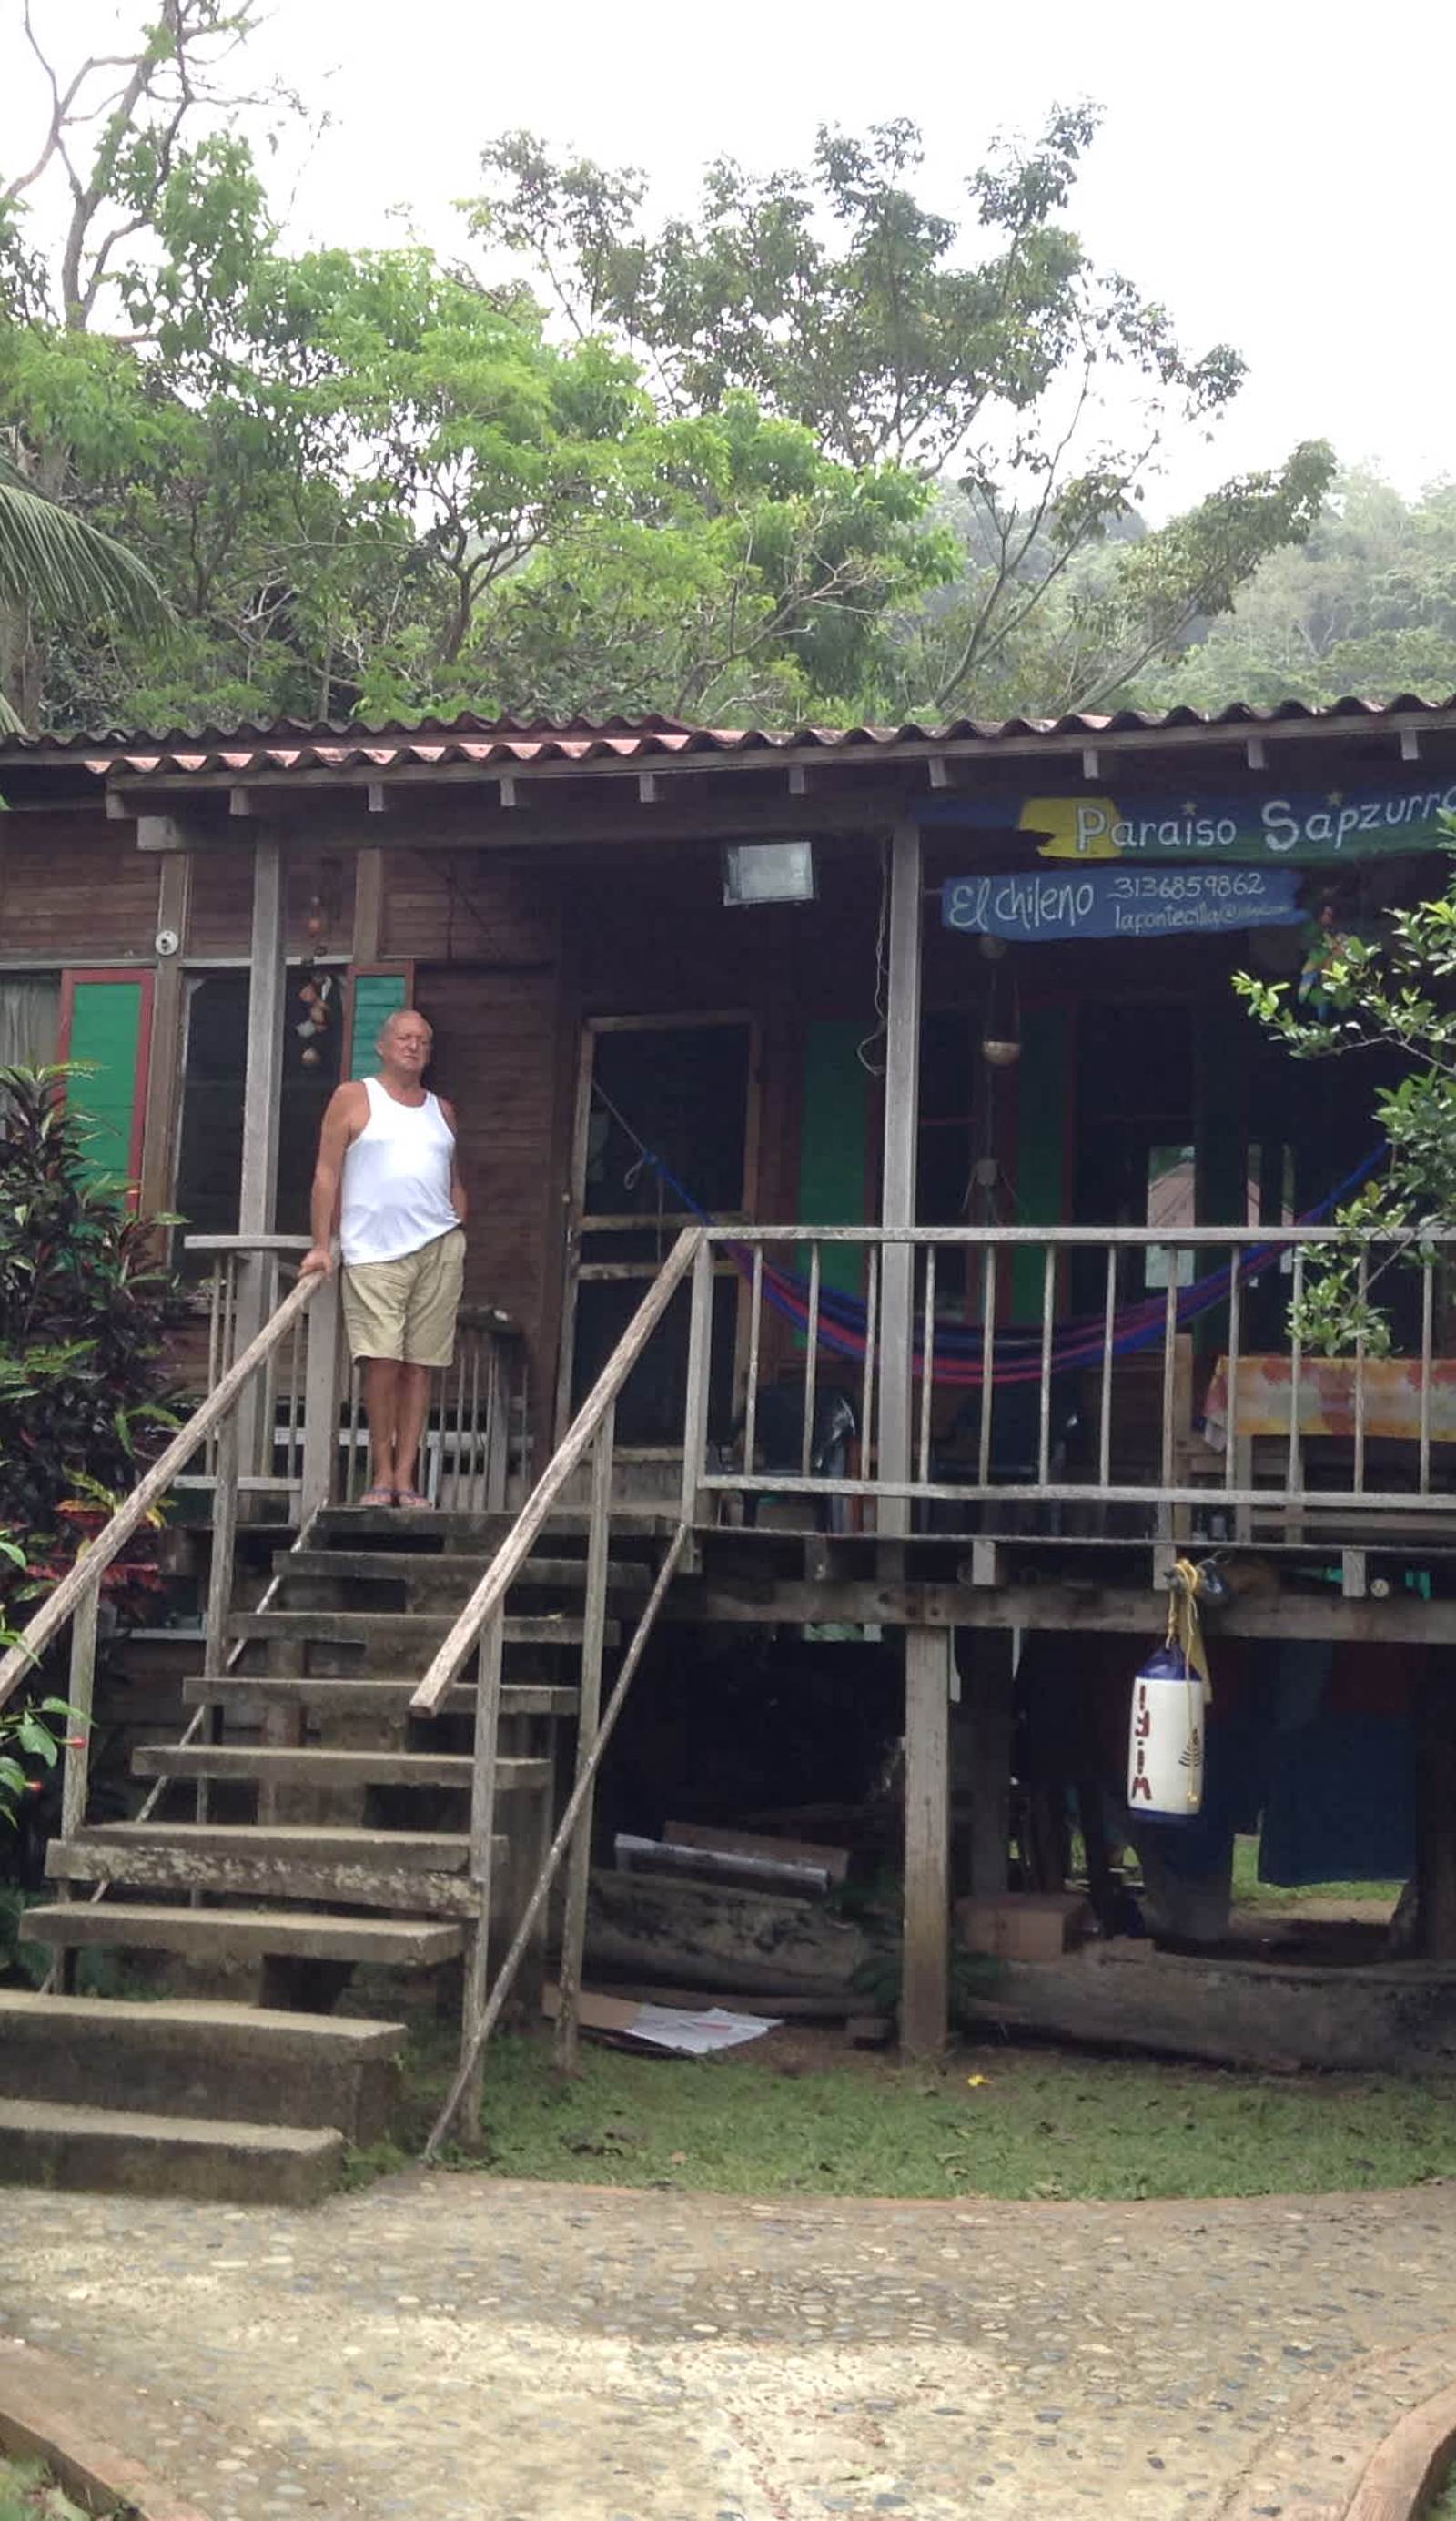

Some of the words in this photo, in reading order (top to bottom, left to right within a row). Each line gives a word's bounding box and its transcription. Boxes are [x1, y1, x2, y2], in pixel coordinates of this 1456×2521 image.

[1077, 805, 1238, 852] Paraiso
[949, 876, 991, 933] El
[1107, 873, 1267, 900] 3136859862
